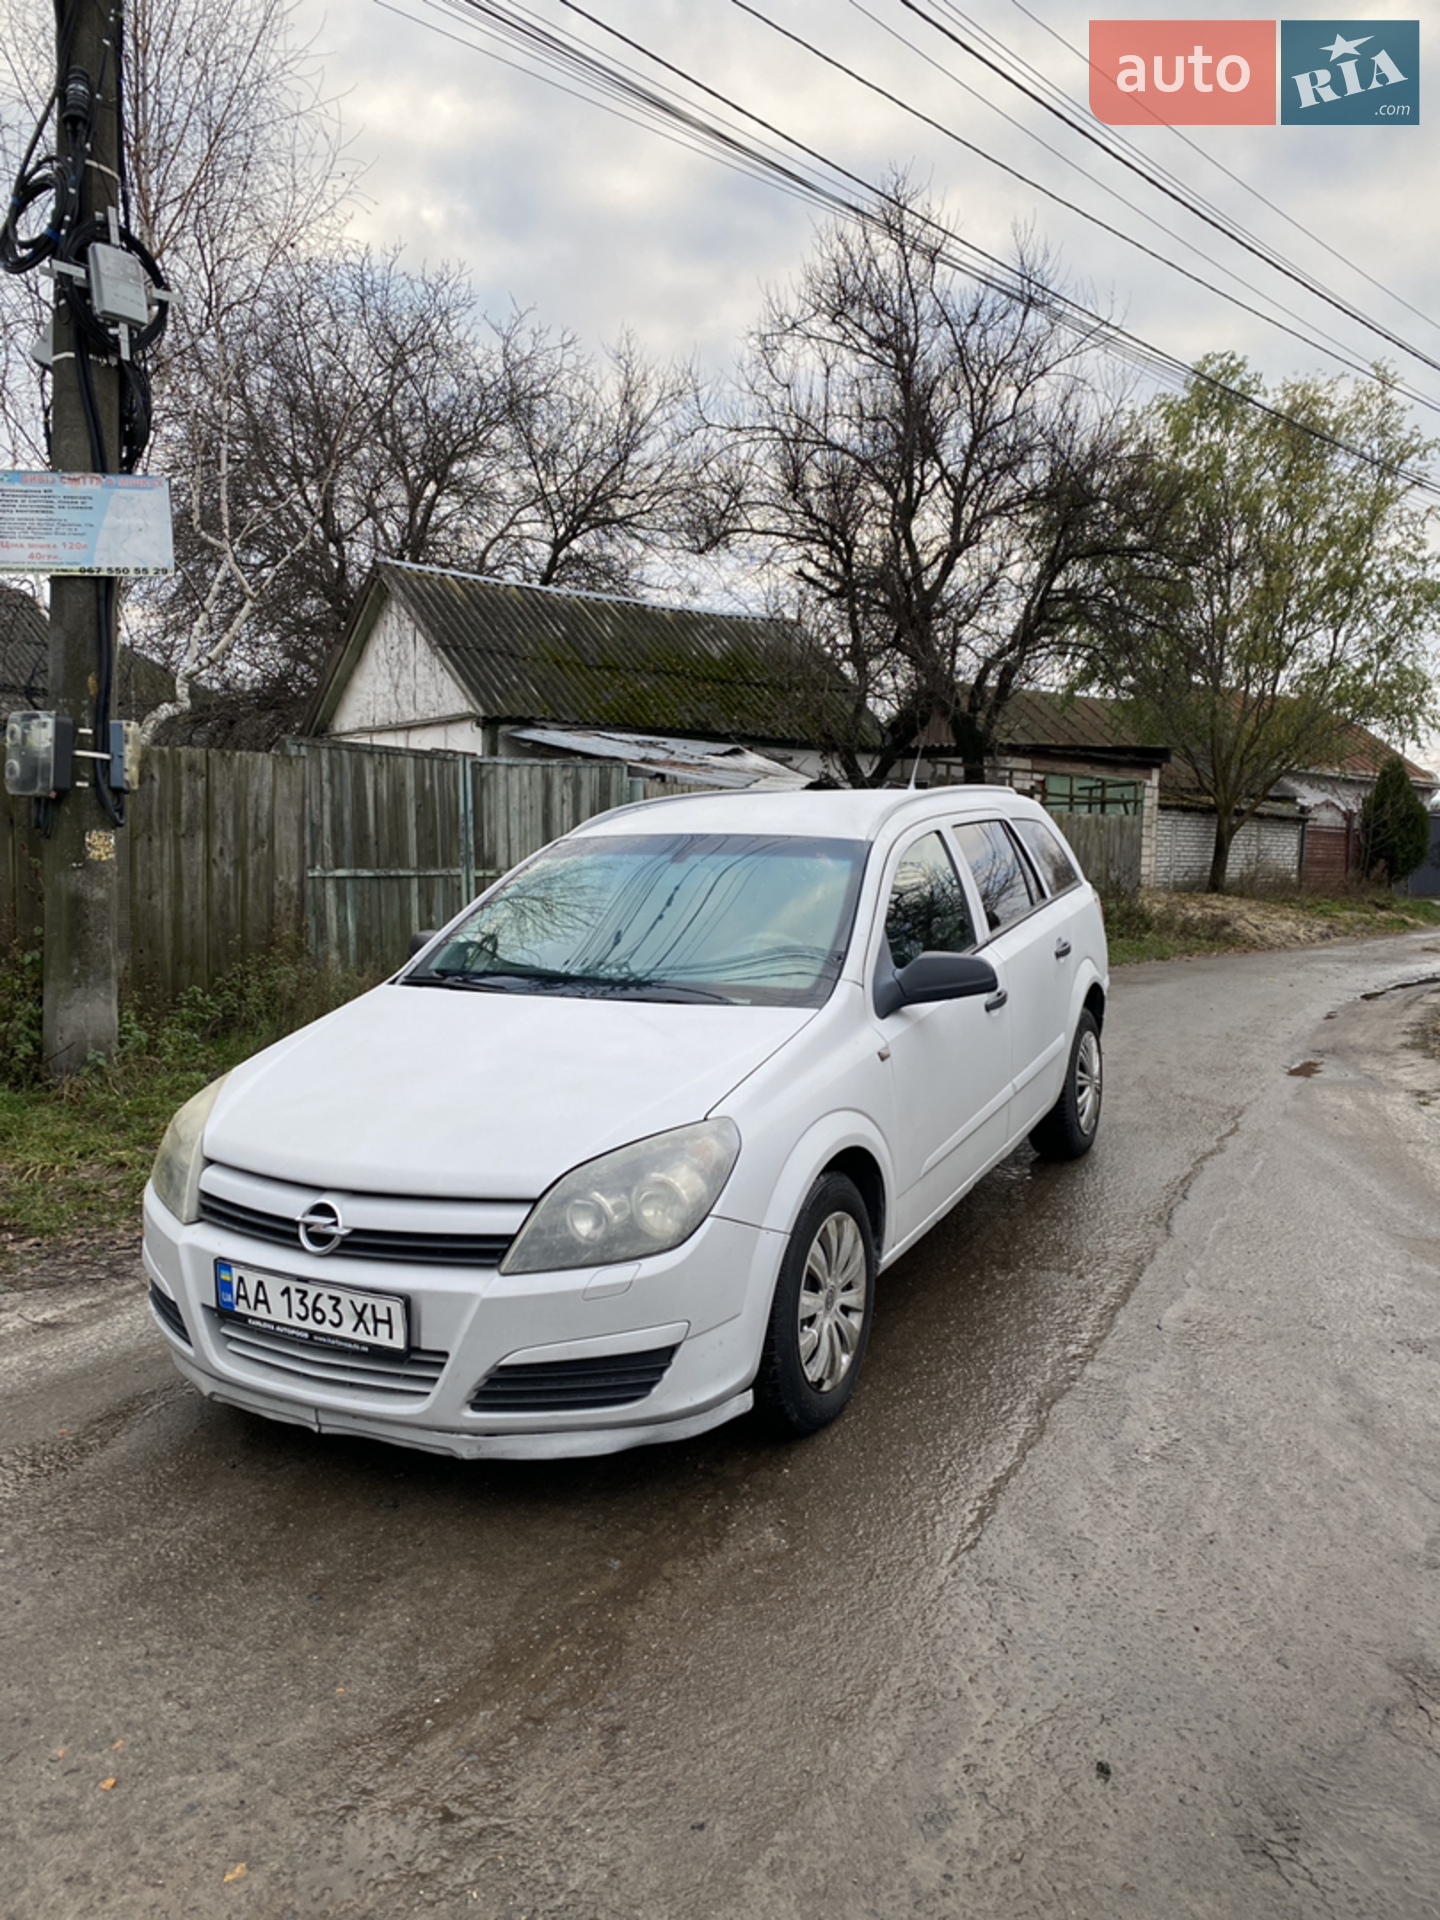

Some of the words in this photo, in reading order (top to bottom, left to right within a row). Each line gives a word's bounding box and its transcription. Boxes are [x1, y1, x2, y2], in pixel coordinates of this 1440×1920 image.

[134, 567, 149, 575] 55
[235, 1275, 271, 1314] AA
[280, 1286, 343, 1328] 1363
[350, 1299, 394, 1340] XH
